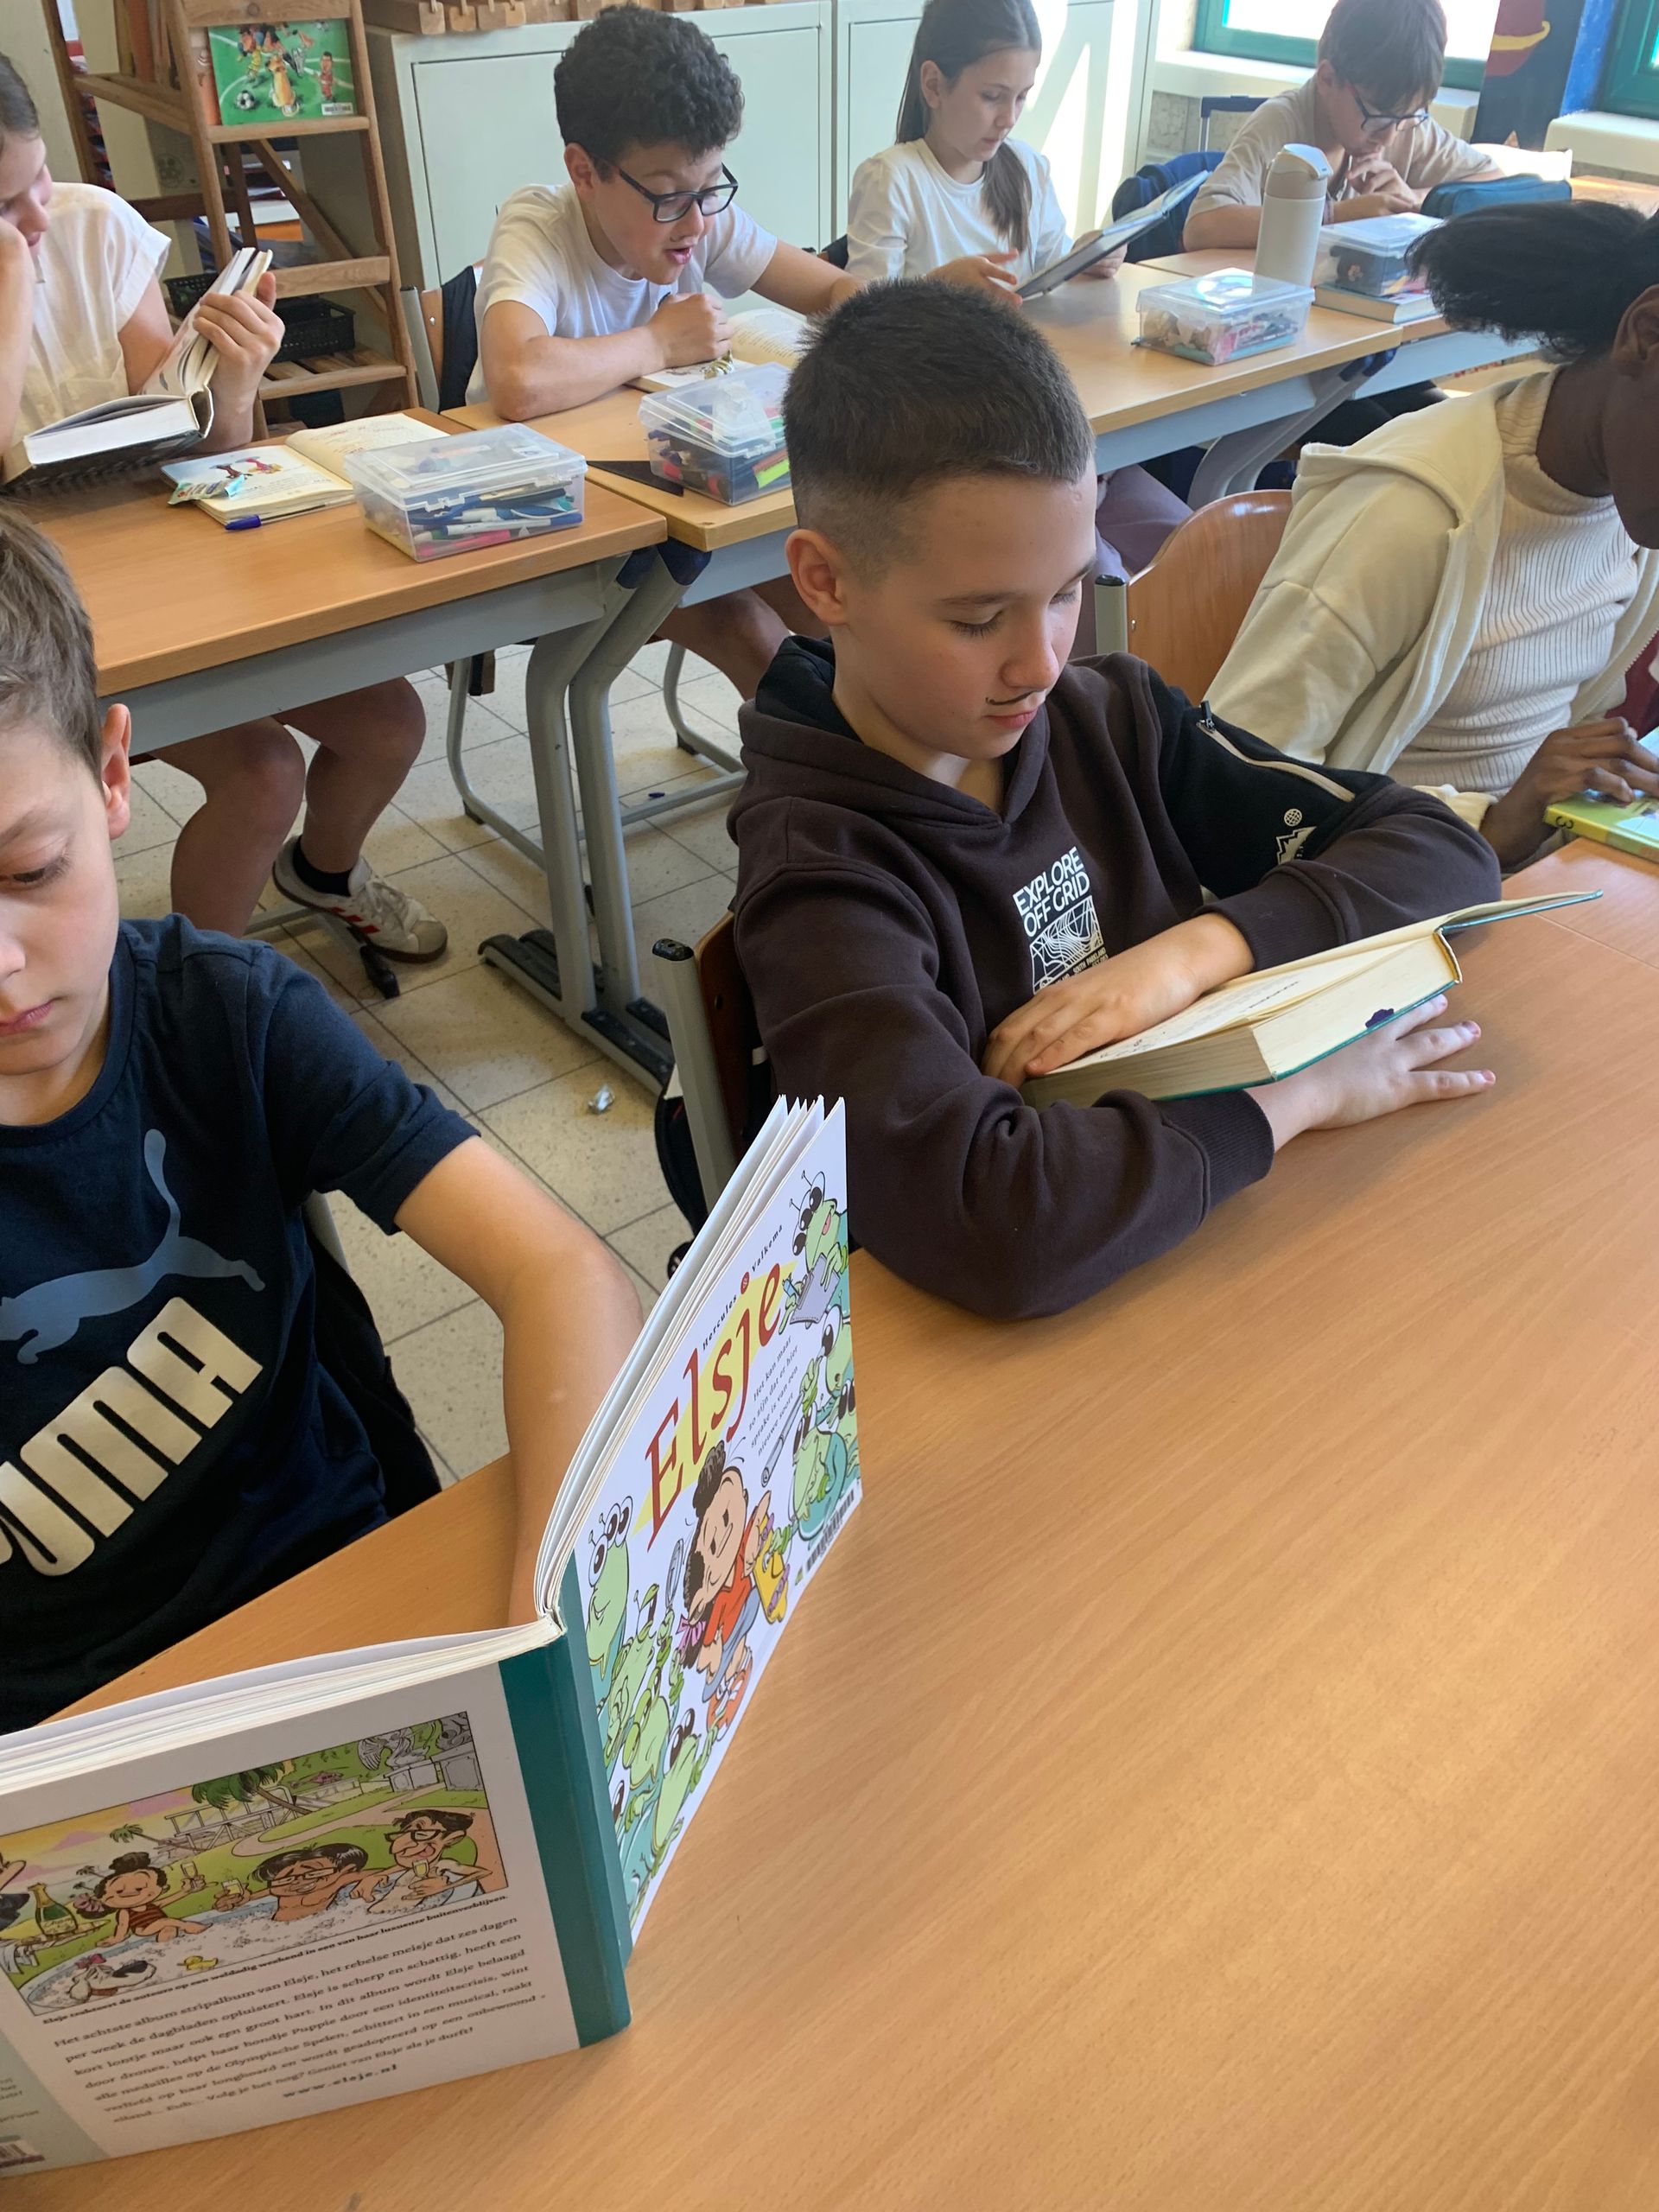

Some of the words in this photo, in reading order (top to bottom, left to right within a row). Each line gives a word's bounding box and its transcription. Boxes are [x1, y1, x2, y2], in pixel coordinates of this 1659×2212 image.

[1013, 846, 1084, 917] EXPLORE
[1024, 895, 1051, 938] OFF
[1052, 871, 1090, 912] GRID
[702, 1294, 737, 1351] Hercules
[752, 1224, 783, 1272] Valkema
[645, 1263, 781, 1553] Elsje
[749, 1415, 756, 1431] zo
[757, 1395, 768, 1419] zijn
[769, 1377, 779, 1396] dat
[779, 1366, 785, 1378] er
[786, 1345, 798, 1367] hier
[751, 1412, 770, 1448] sprake
[771, 1400, 777, 1413] is
[778, 1384, 788, 1402] van
[788, 1365, 798, 1383] een
[753, 1382, 765, 1402] Het
[766, 1361, 777, 1382] kan
[777, 1335, 791, 1362] maar
[0, 1296, 264, 1577] UMA
[758, 1420, 778, 1457] nieuwe
[779, 1392, 793, 1420] soort
[53, 2036, 79, 2047] Het
[82, 2023, 131, 2039] achtste
[134, 2011, 177, 2025] album
[180, 1990, 255, 2014] stripalbum
[257, 1983, 281, 1993] van
[283, 1974, 318, 1986] Elsje,
[320, 1966, 341, 1976] het
[344, 1953, 389, 1970] rebelse
[391, 1941, 433, 1956] meisje
[435, 1934, 455, 1944] dat
[457, 1929, 477, 1938] zes
[480, 1917, 518, 1932] dagen
[65, 2051, 86, 2063] per
[90, 2042, 126, 2054] week
[149, 2018, 218, 2039] dagbladen
[293, 1989, 323, 2001] Elsje
[341, 1972, 385, 1988] scherp
[388, 1967, 404, 1975] en
[464, 1940, 496, 1954] heeft
[499, 1934, 521, 1944] een
[73, 2064, 103, 2075] kort
[106, 2053, 146, 2067] lontje
[150, 2043, 184, 2056] maar
[189, 2035, 213, 2045] ook
[245, 2018, 280, 2032] groot
[337, 1997, 354, 2005] dit
[359, 1985, 399, 2000] album
[404, 1974, 440, 1987] wordt
[444, 1964, 474, 1976] Elsje
[477, 1948, 524, 1967] belaagd
[85, 2077, 115, 2088] door
[119, 2064, 169, 2079] drones,
[172, 2053, 207, 2066] helpt
[210, 2045, 238, 2056] haar
[243, 2031, 288, 2047] hondje
[291, 2018, 335, 2034] Puppie
[340, 2010, 368, 2021] door
[372, 2003, 394, 2012] een
[500, 1966, 528, 1977] wint
[94, 2092, 117, 2101] alle
[120, 2075, 182, 2094] medailles
[224, 2044, 299, 2067] Olympische
[352, 2016, 404, 2034] schittert
[423, 2005, 444, 2014] een
[448, 1989, 499, 2007] musical,
[501, 1980, 531, 1993] raakt
[178, 2082, 207, 2094] haar
[301, 2049, 338, 2062] wordt
[343, 2026, 416, 2053] geadopteerd
[422, 2022, 437, 2031] op
[442, 2015, 462, 2024] een
[467, 1994, 536, 2018] onbewoond
[283, 2063, 397, 2097] www.elsje.nl
[350, 2055, 372, 2064] van
[374, 2047, 403, 2058] Elsje
[438, 2026, 473, 2041] durft!
